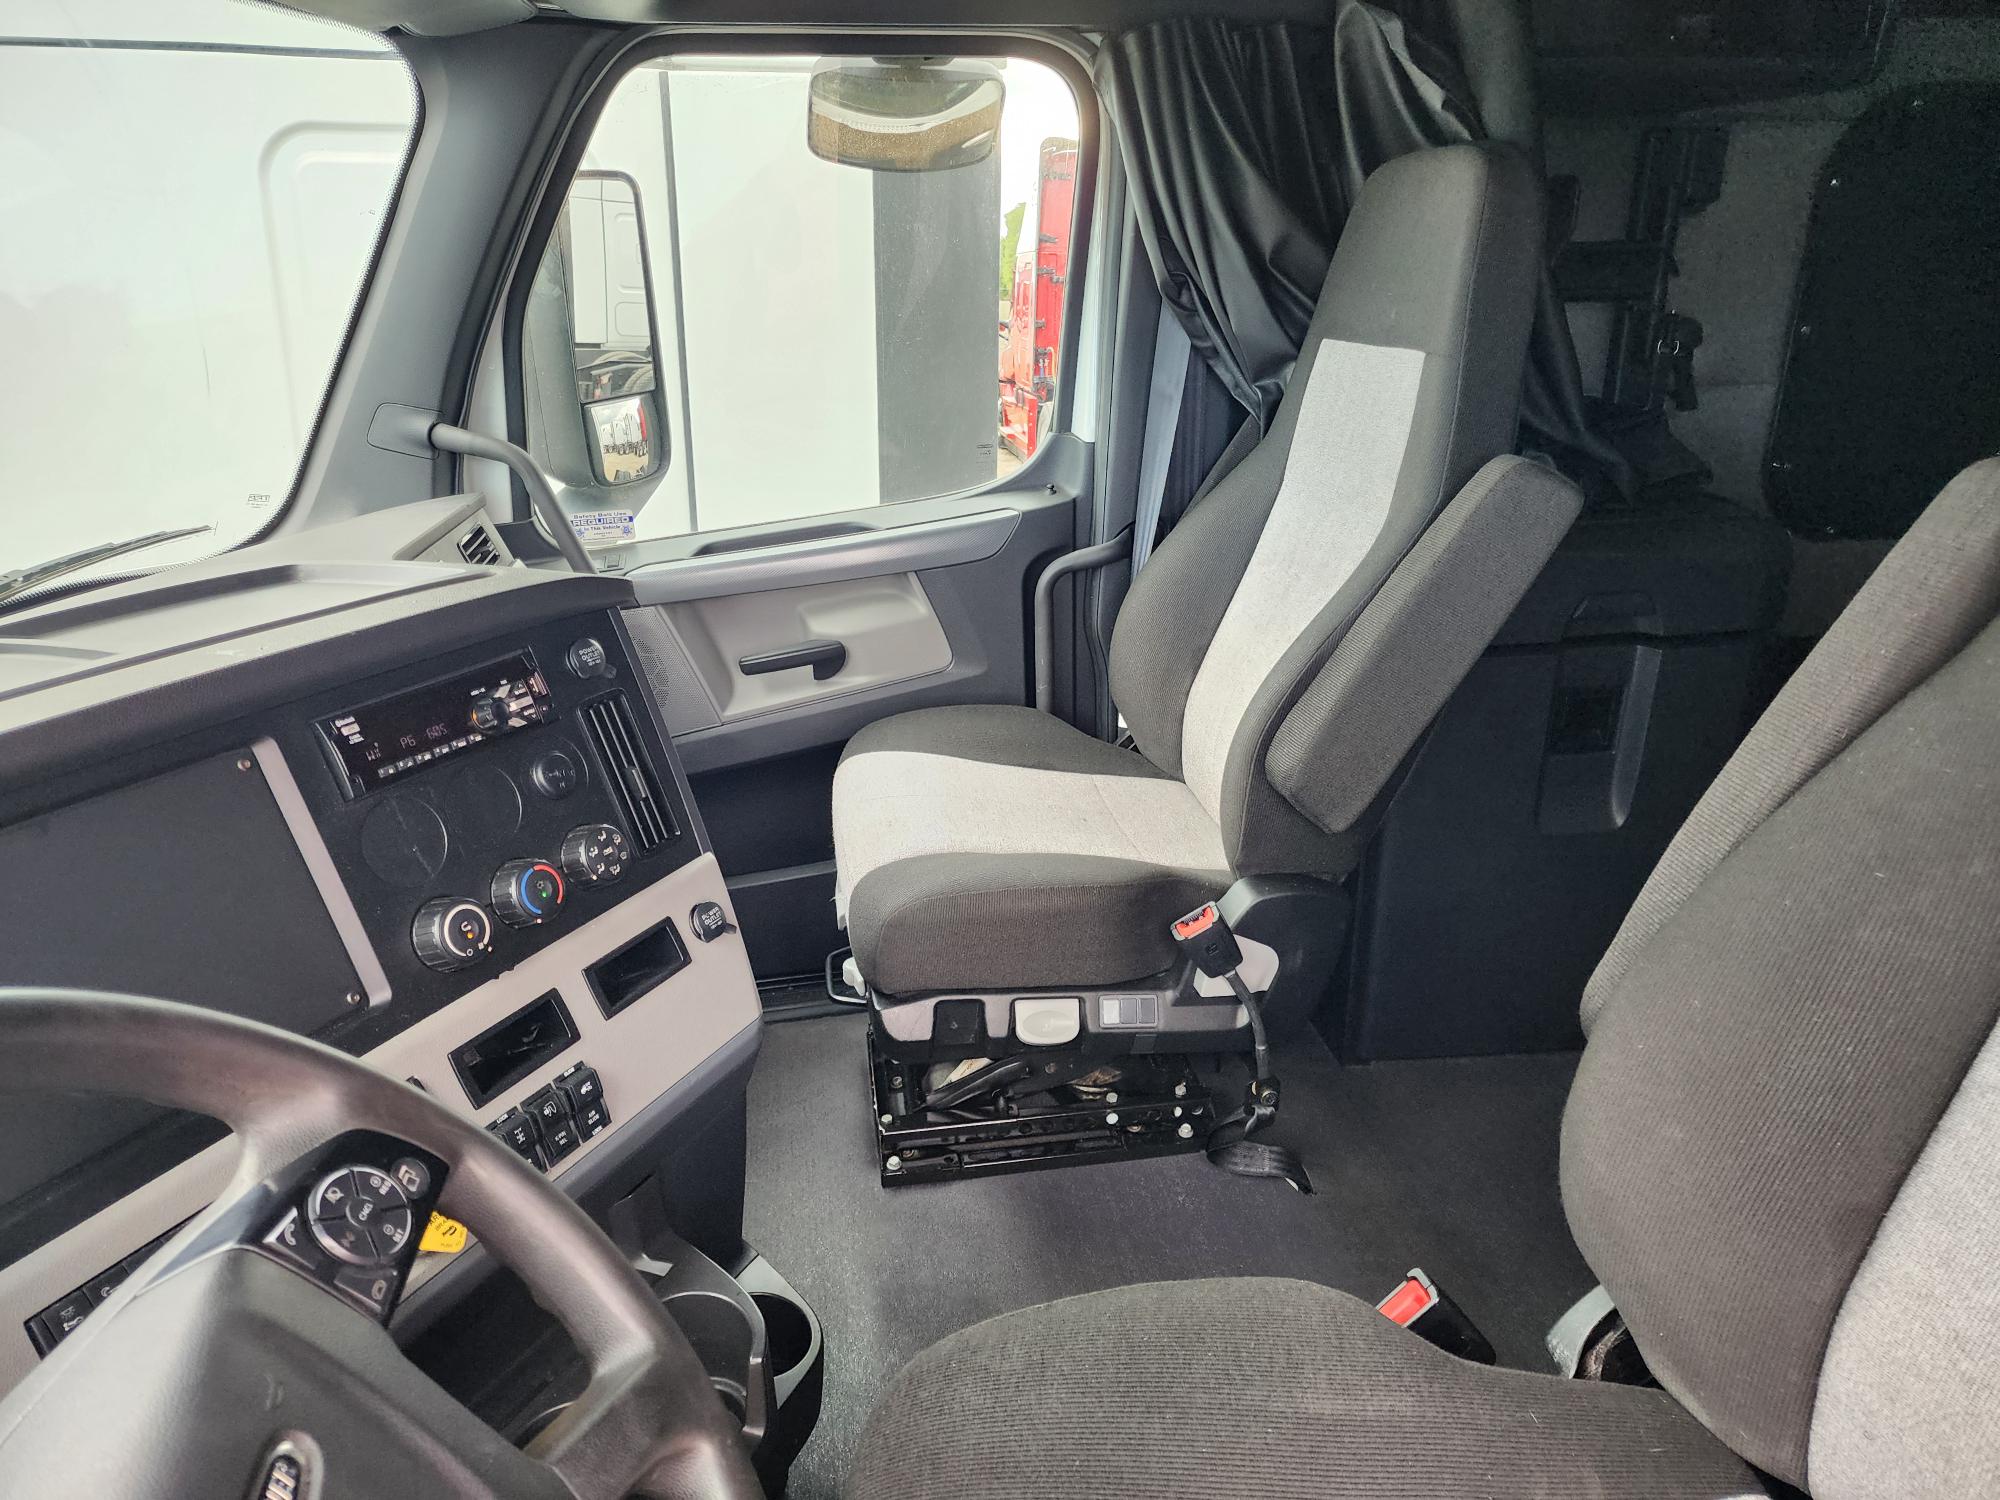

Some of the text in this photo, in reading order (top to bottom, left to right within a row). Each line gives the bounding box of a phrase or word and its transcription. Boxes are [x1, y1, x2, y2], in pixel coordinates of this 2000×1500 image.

[572, 516, 630, 527] REQUIRED
[579, 647, 599, 655] POWER
[582, 651, 600, 660] OUTLET
[702, 907, 719, 920] POWER
[705, 911, 721, 925] OUTLET
[497, 1114, 508, 1123] LOCK
